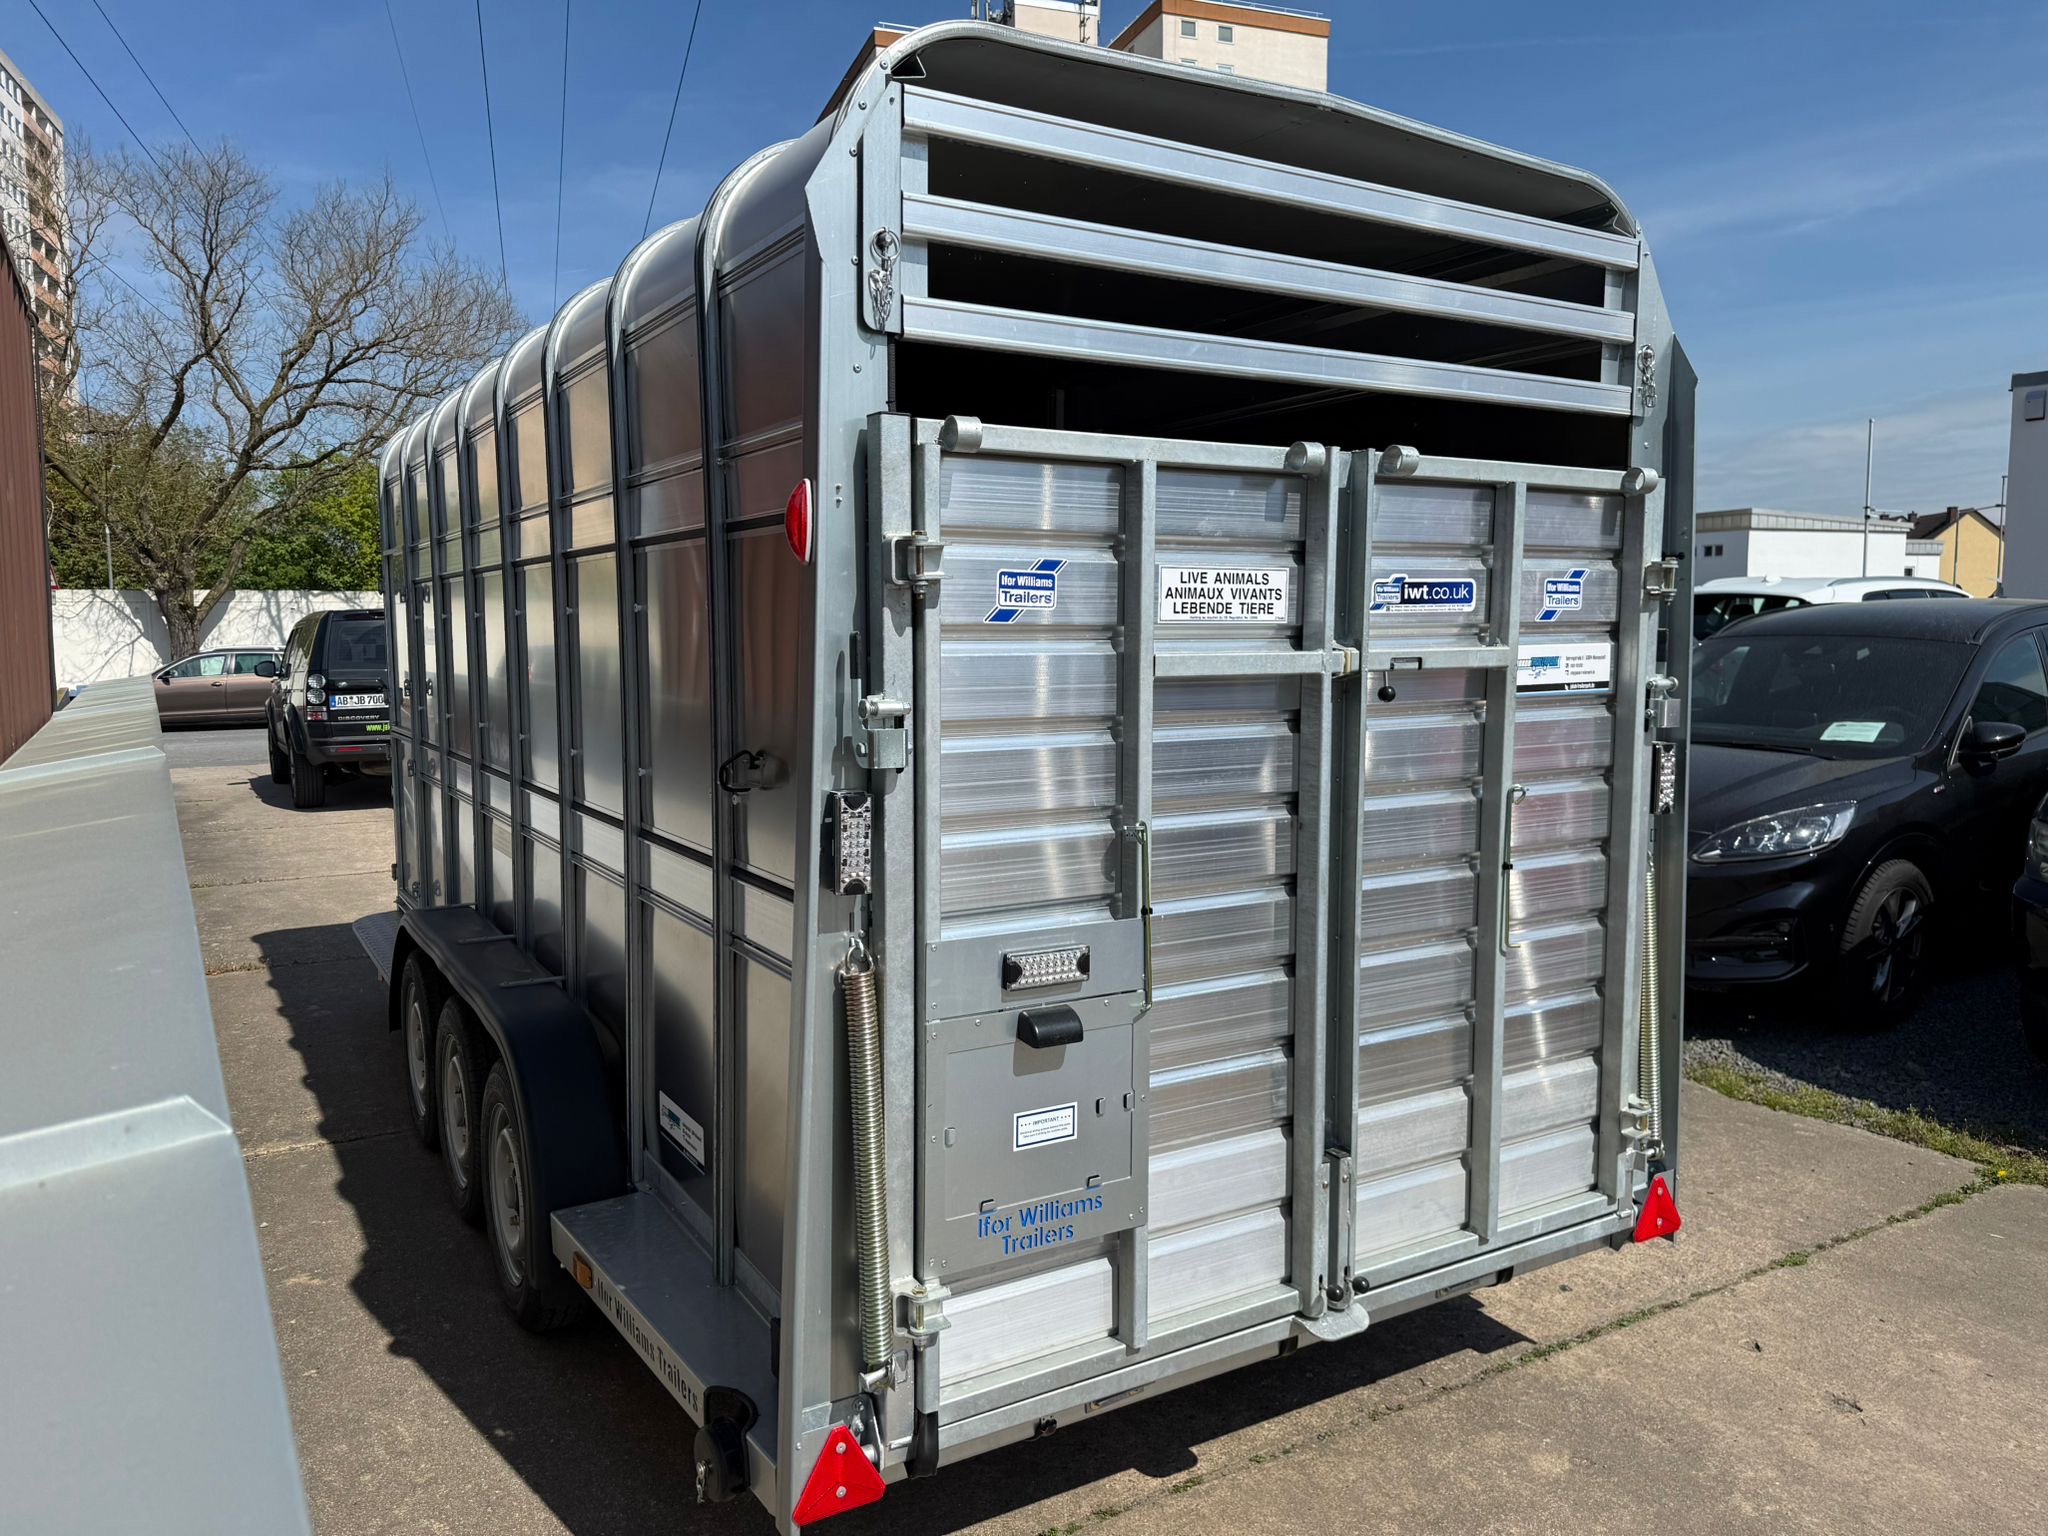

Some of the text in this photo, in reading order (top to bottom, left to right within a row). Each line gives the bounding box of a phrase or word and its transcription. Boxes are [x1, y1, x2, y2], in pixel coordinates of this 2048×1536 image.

[1001, 574, 1053, 588] Ifor Williams
[1180, 571, 1270, 585] LIVE ANIMALS
[1165, 587, 1282, 601] ANIMAUX VIVANTS
[1404, 584, 1469, 600] iwt.co.uk
[1557, 582, 1580, 592] Williams
[1001, 590, 1053, 604] Trailers
[1547, 595, 1579, 605] Trailers
[1173, 602, 1275, 615] LEBENDE TIERE
[337, 696, 348, 705] AB
[355, 695, 366, 705] JB
[978, 1195, 1103, 1239] Ifor Williams
[1002, 1224, 1074, 1255] Trailers
[597, 1278, 698, 1413] Ifor Williams Trailers
